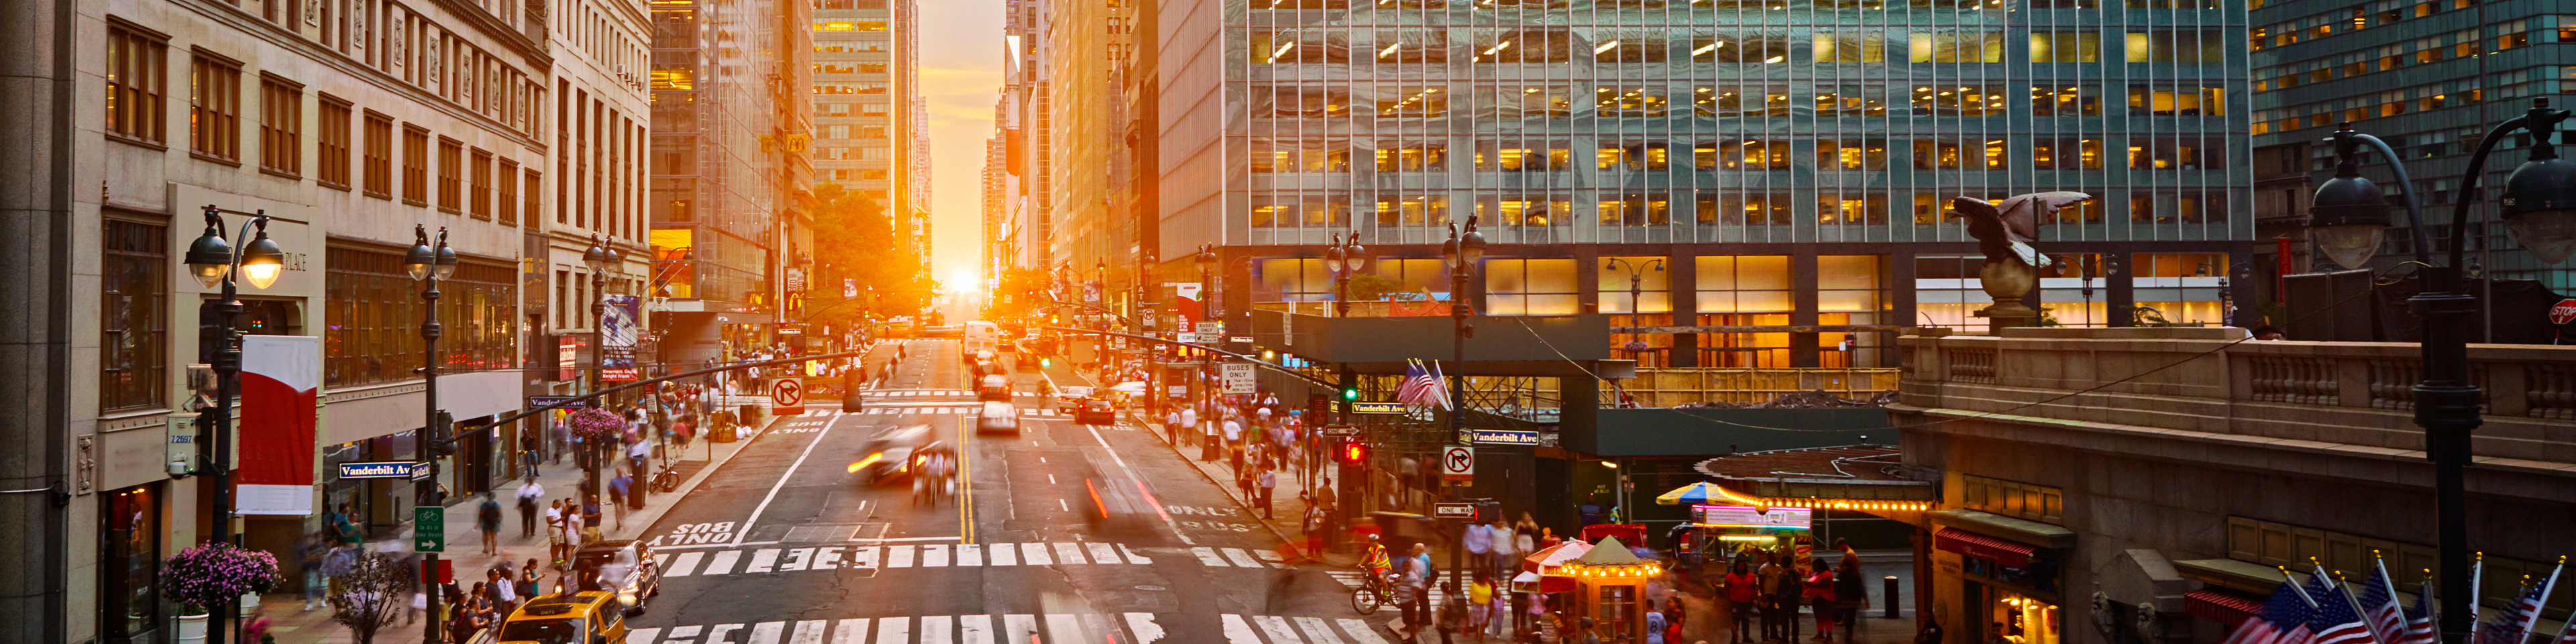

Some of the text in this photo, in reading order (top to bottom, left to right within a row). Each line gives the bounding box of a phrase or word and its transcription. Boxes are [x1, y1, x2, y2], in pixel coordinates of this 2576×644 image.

[285, 252, 307, 272] PLACE
[2553, 307, 2576, 316] STOP
[1473, 433, 1537, 443] Vanderbilt Ave
[342, 465, 410, 476] Vanderbilt Av
[1168, 505, 1237, 517] ONLY
[672, 521, 736, 534] BUS
[645, 532, 733, 546] ONLY
[1650, 621, 1658, 634] 8
